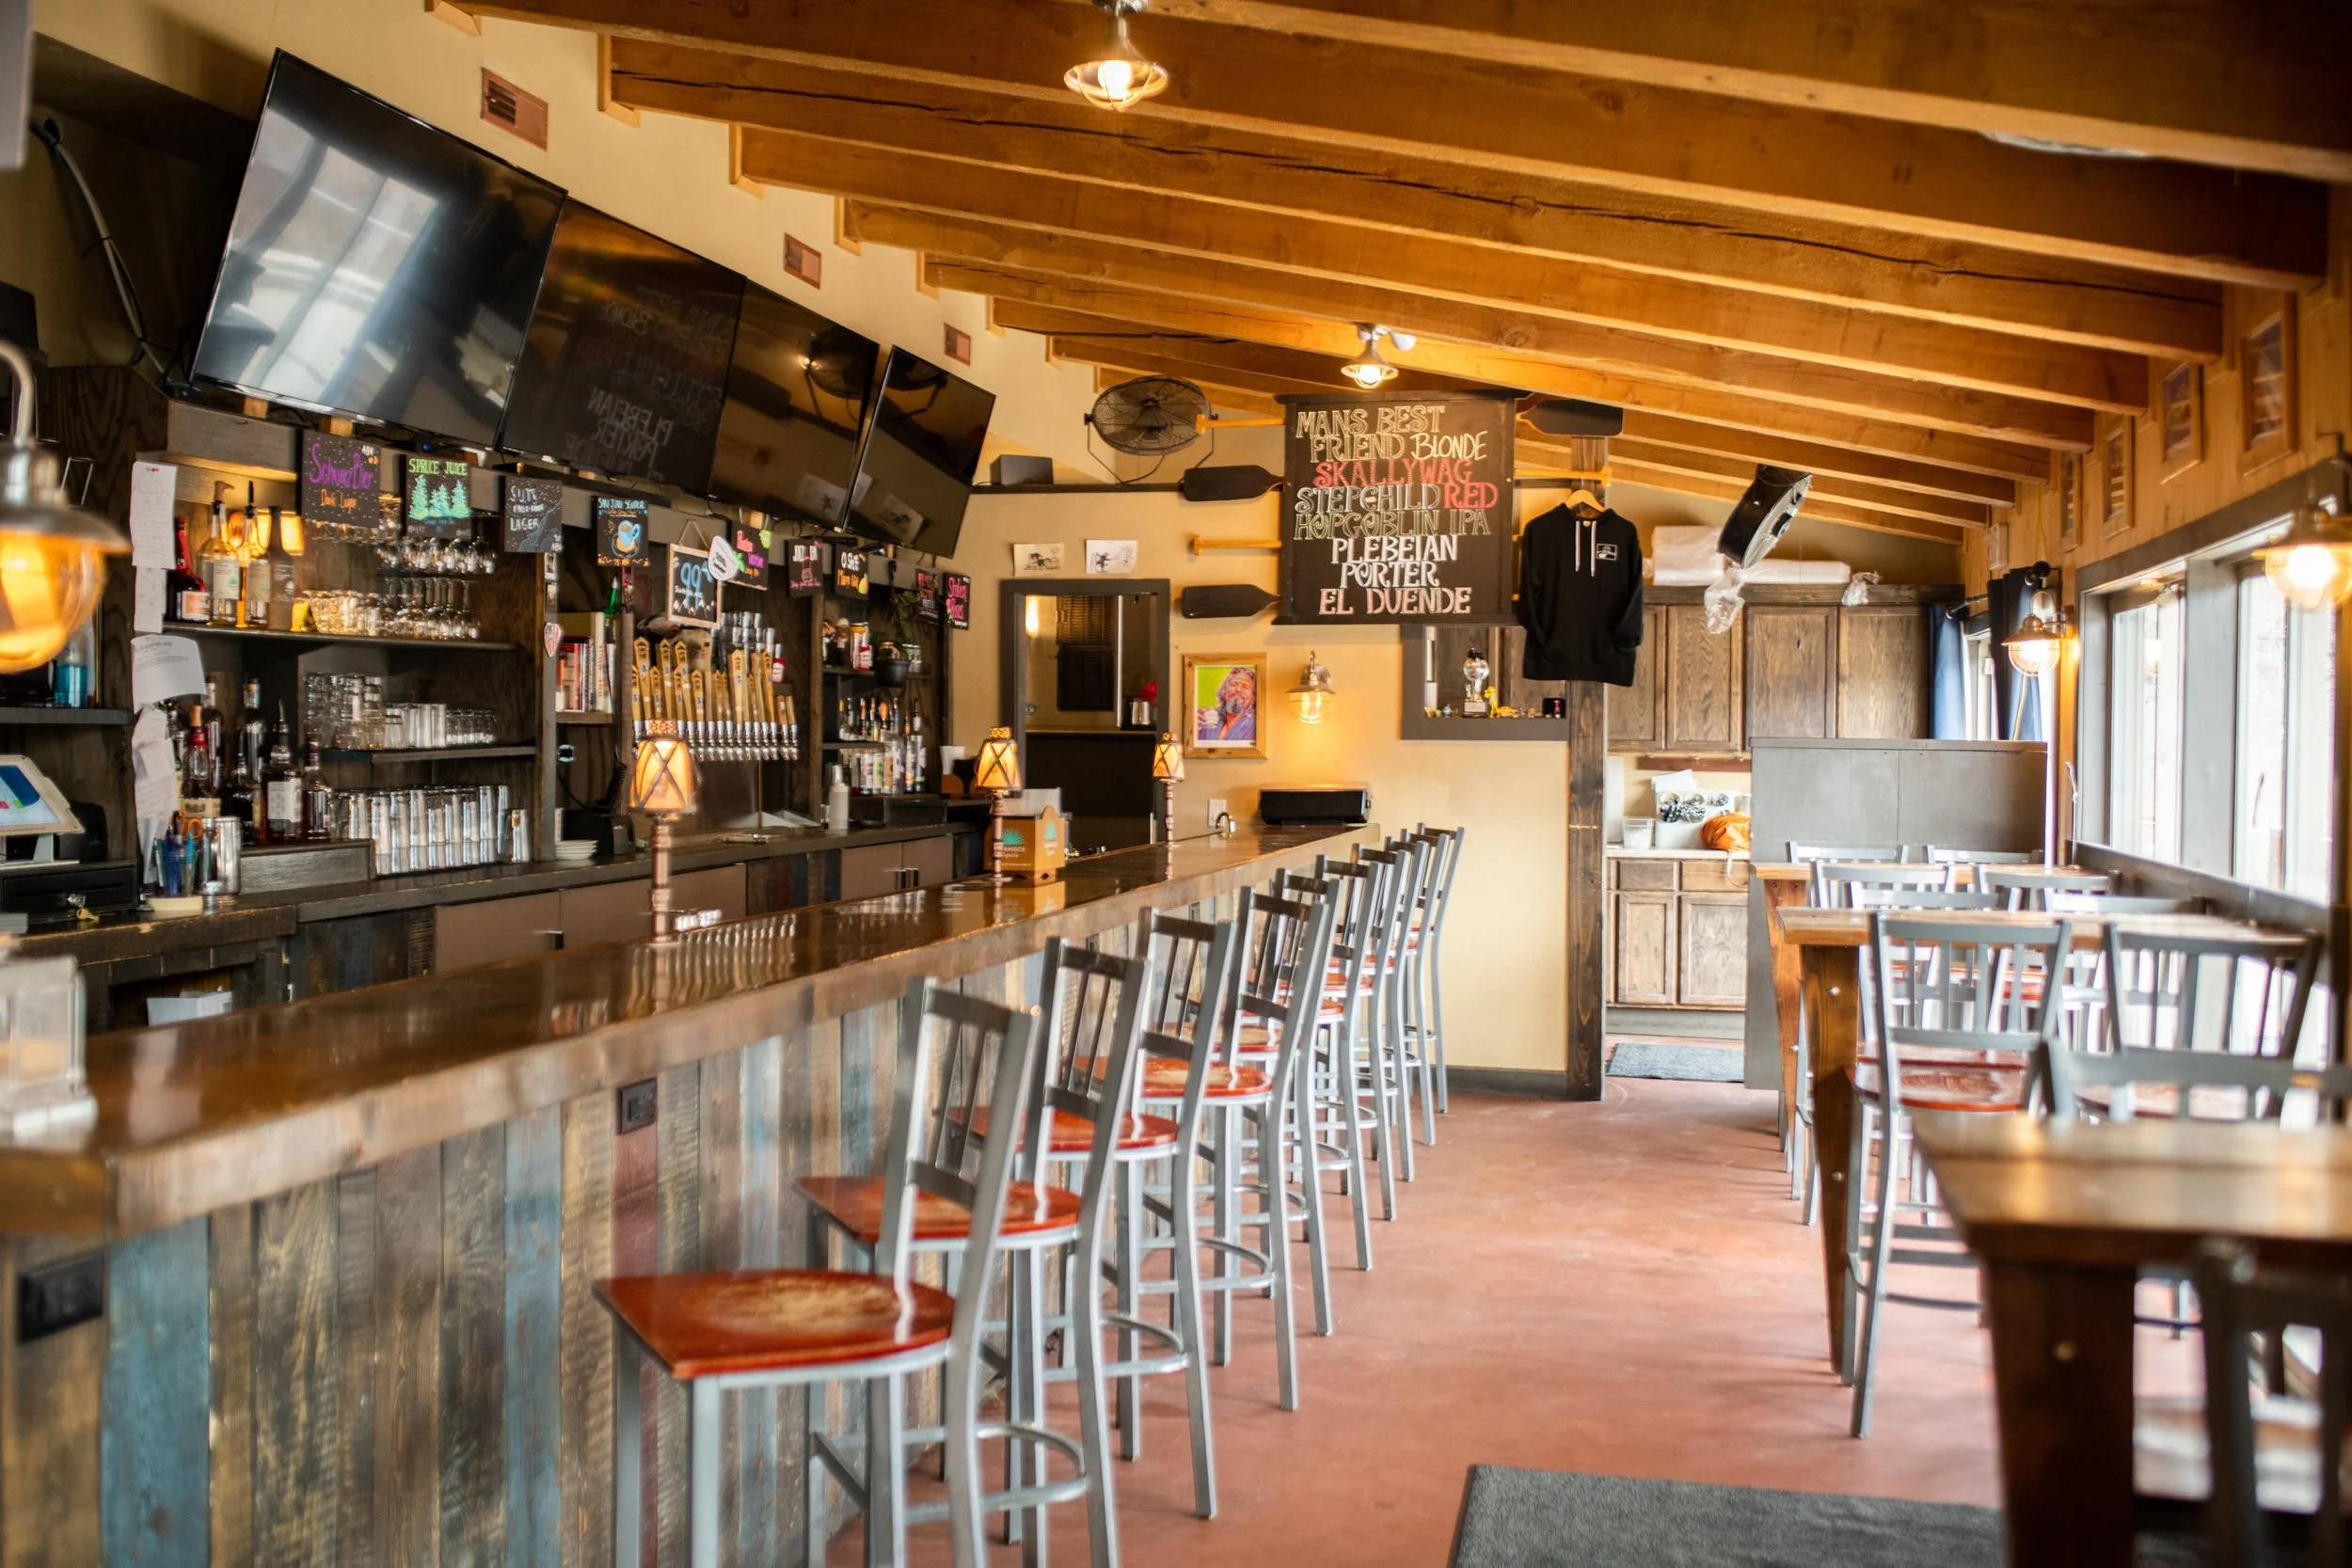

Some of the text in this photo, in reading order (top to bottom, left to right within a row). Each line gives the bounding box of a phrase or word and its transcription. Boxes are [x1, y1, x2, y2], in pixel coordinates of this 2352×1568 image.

[1295, 405, 1445, 438] MANS BEST
[1310, 430, 1488, 462] FRIEND BLONDE
[408, 458, 468, 476] SPRUCE JUICE
[1313, 458, 1474, 487] SKALLYWAG
[1295, 483, 1441, 514] STEPCHILD
[1443, 482, 1499, 509] RED
[510, 517, 539, 531] LAGER
[1294, 508, 1491, 540] HOPGOBLIN IPA
[1331, 534, 1457, 564] PLEBEIAN
[1340, 562, 1439, 589] PORTER
[1318, 587, 1472, 615] EL DUENDE
